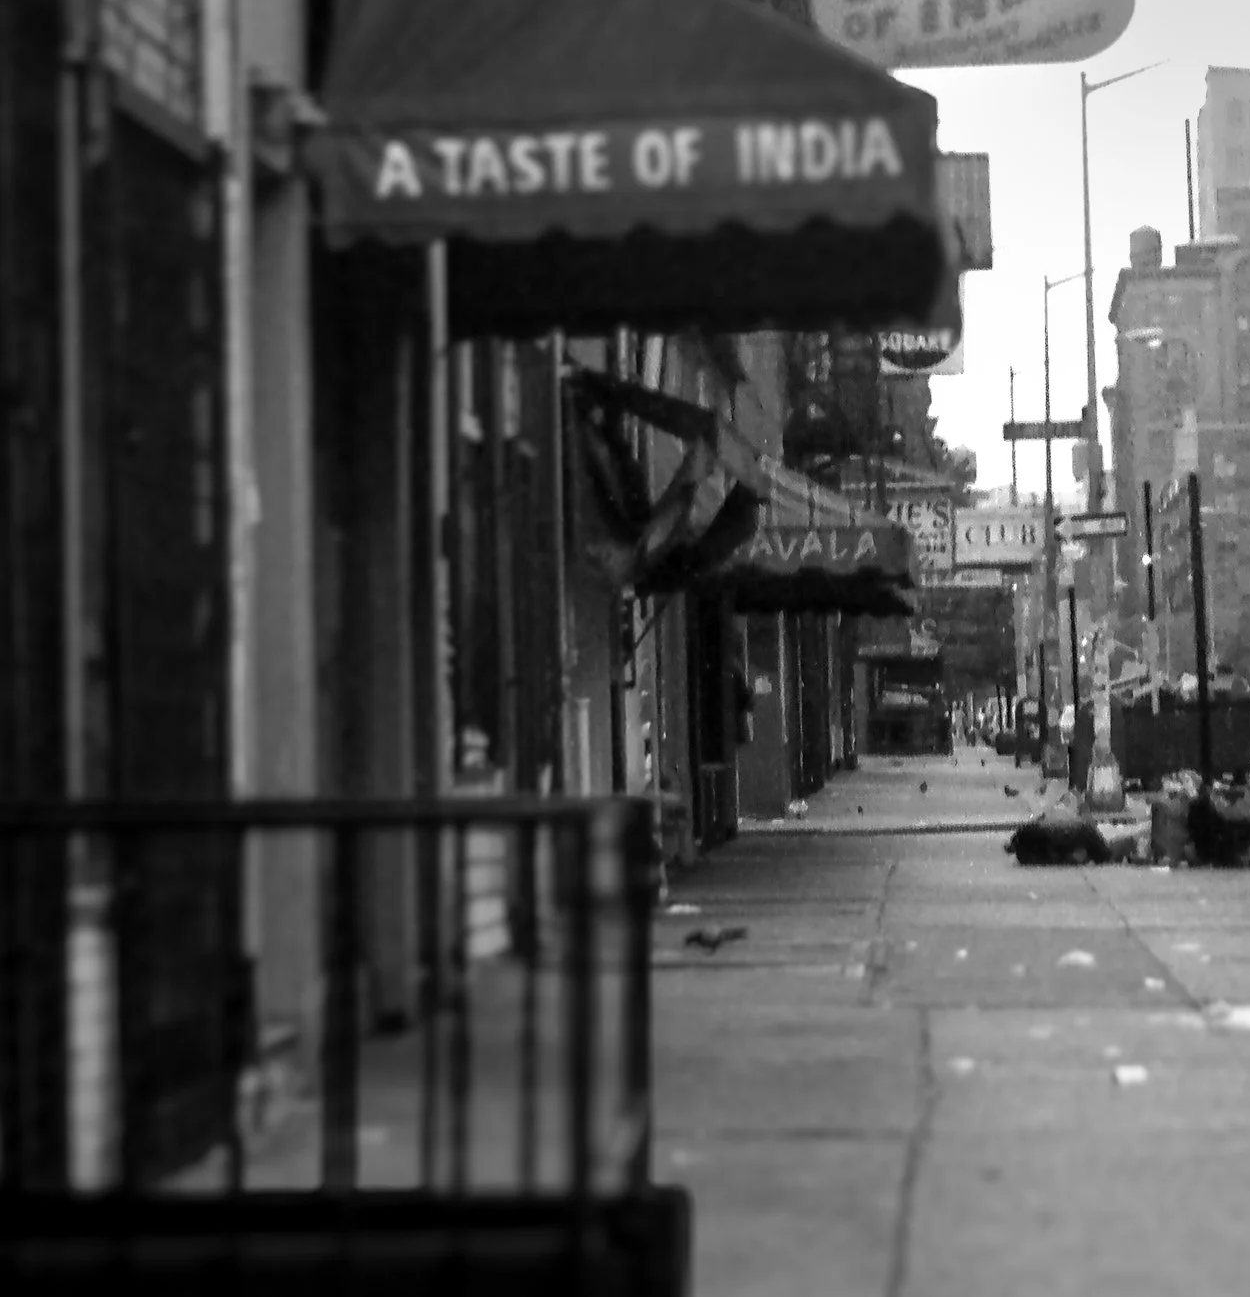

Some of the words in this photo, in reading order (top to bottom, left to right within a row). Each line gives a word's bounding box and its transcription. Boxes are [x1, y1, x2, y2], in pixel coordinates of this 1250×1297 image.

[844, 8, 897, 42] OF
[376, 140, 421, 198] A
[433, 131, 613, 196] TASTE
[632, 127, 702, 188] OF
[735, 117, 902, 185] INDIA
[964, 523, 1037, 549] CLUB
